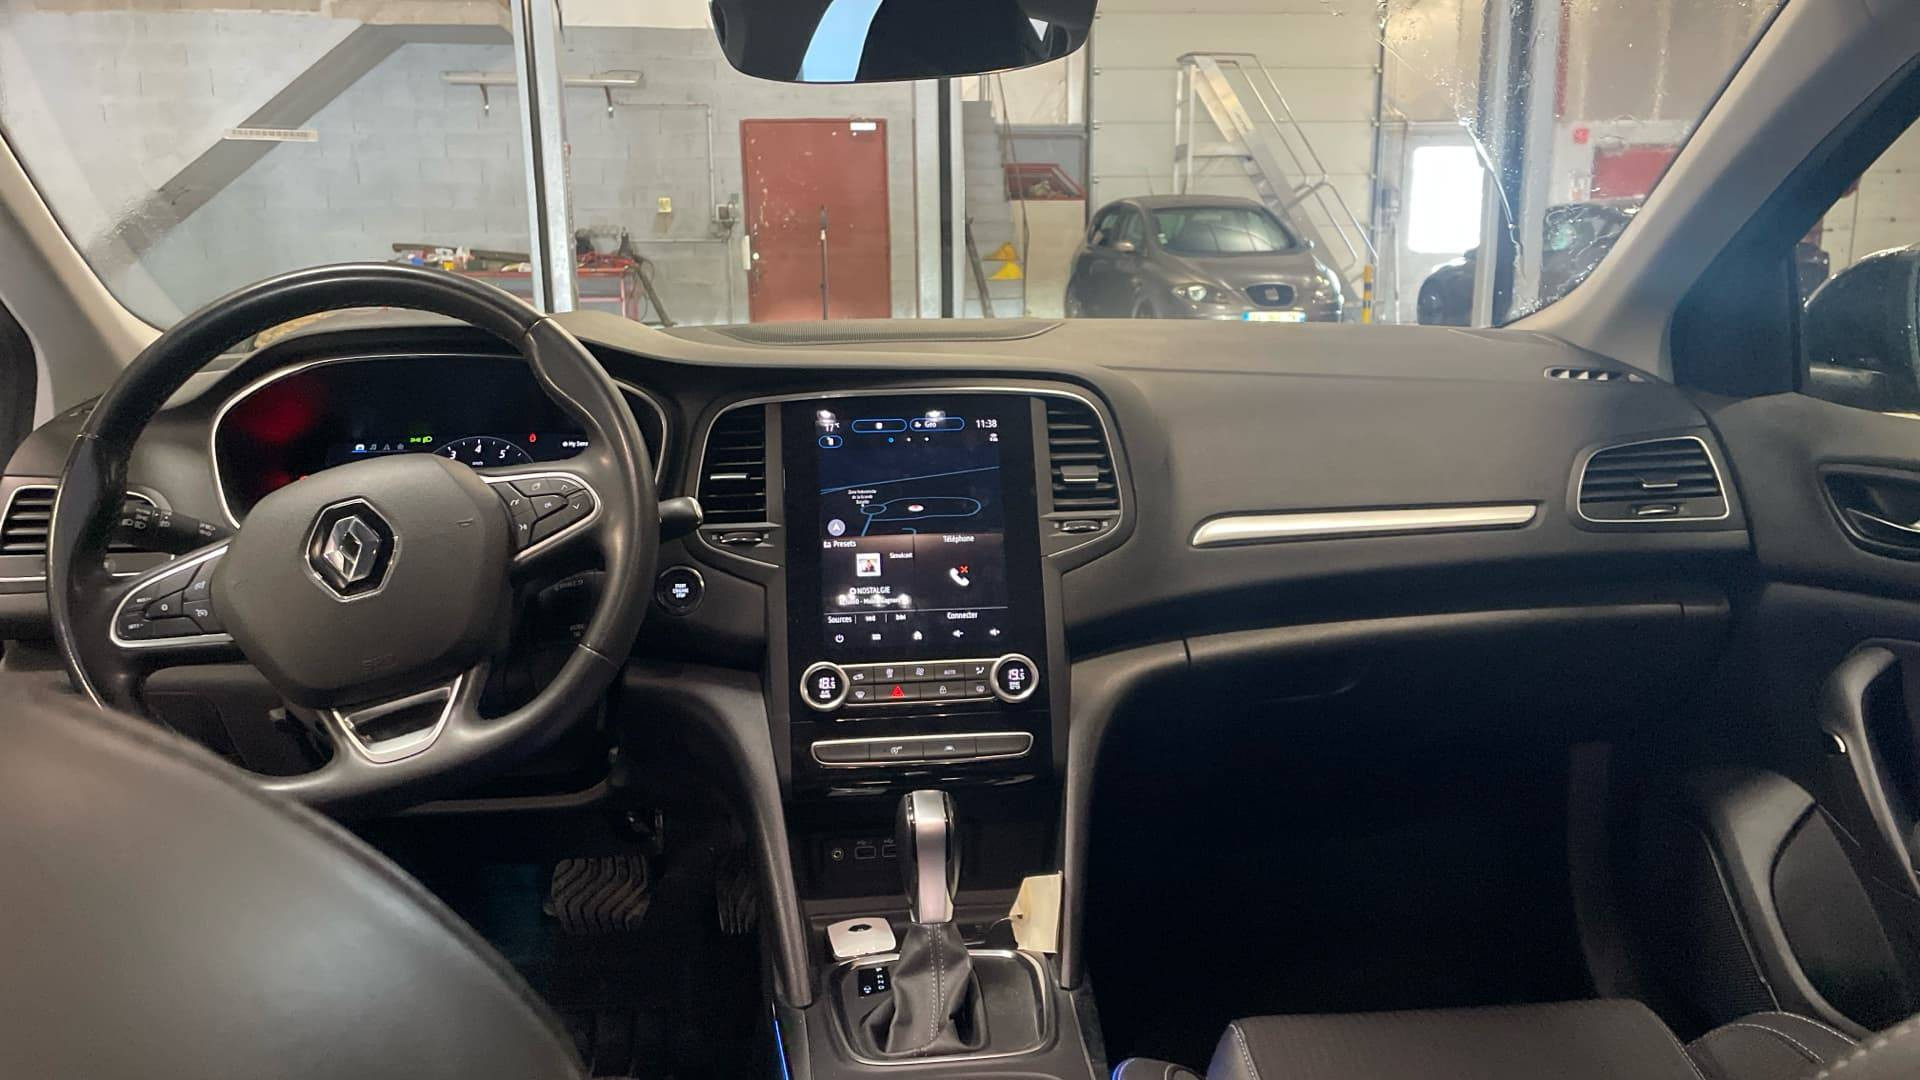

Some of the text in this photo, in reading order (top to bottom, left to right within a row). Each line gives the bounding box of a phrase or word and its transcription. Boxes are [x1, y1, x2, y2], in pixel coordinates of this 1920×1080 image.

[976, 419, 998, 429] 11:38
[475, 444, 482, 453] 4
[450, 450, 457, 460] 3
[499, 449, 506, 459] 5
[833, 540, 857, 548] Presets
[857, 586, 891, 594] NOSTALGIE
[827, 615, 853, 624] Sources
[947, 611, 978, 620] Connecter
